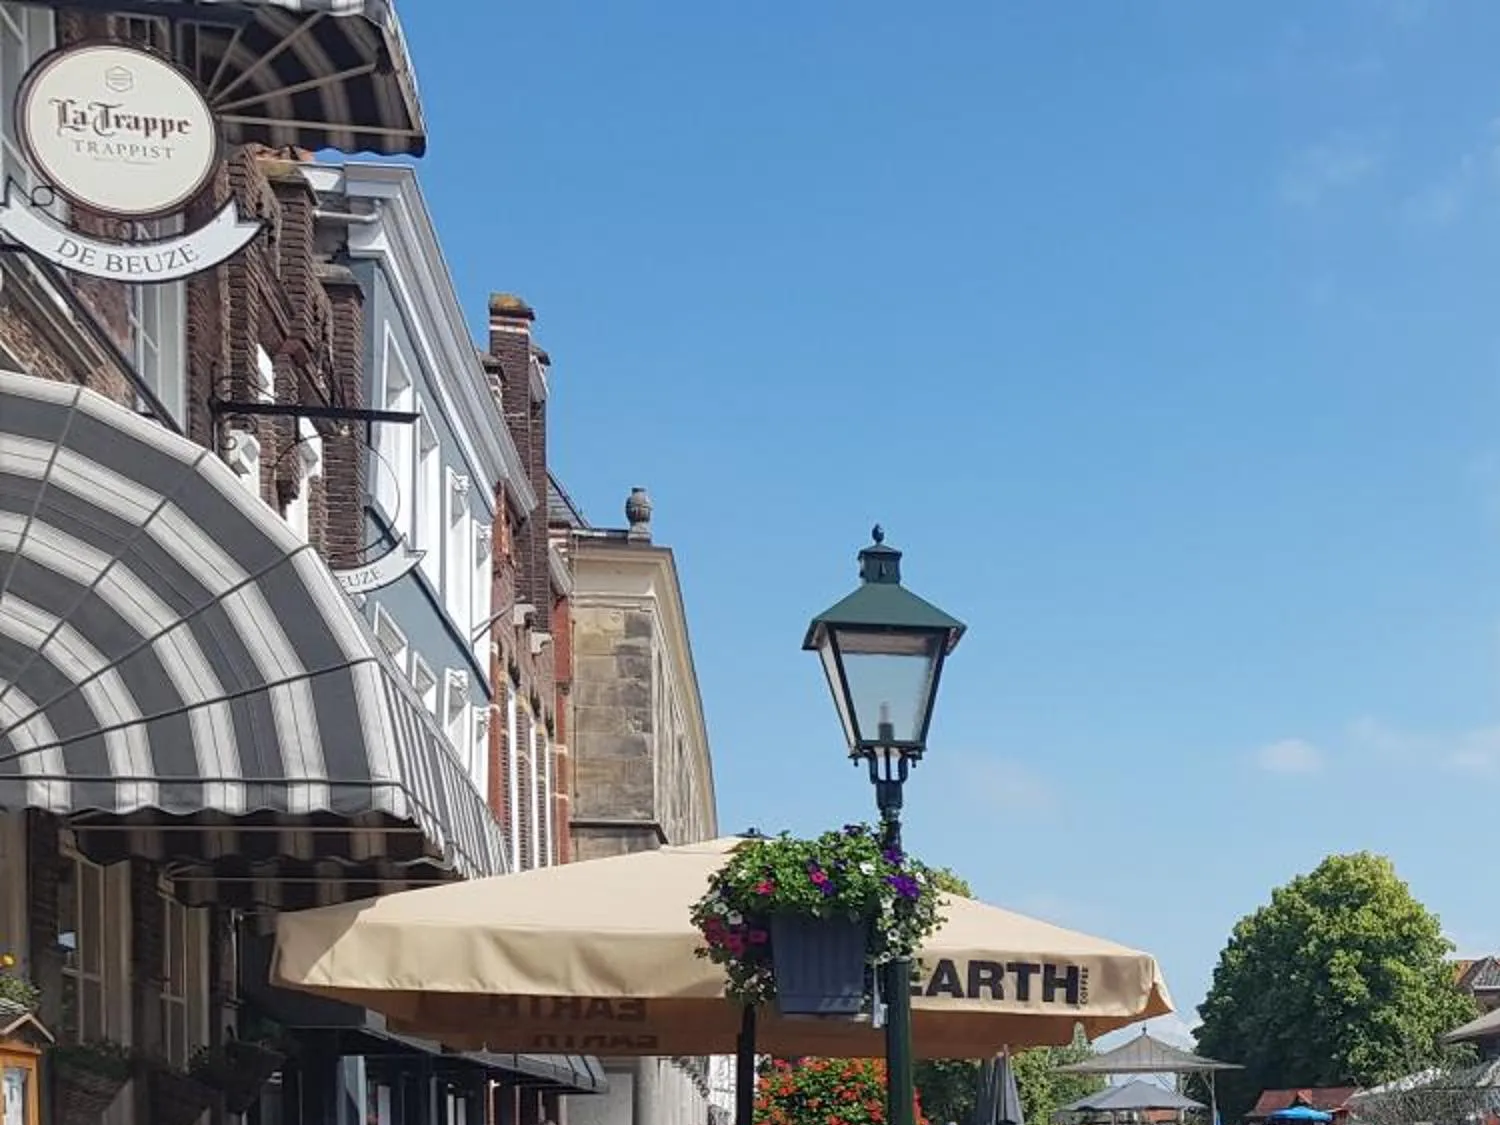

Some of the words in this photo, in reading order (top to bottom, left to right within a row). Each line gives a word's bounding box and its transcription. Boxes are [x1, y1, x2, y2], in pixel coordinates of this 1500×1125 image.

[48, 98, 88, 136] La
[87, 102, 192, 139] Trappe
[72, 139, 176, 159] TRAPPIST
[56, 238, 97, 267] DE
[104, 243, 199, 275] BEUZE
[910, 957, 1079, 1004] ARTH
